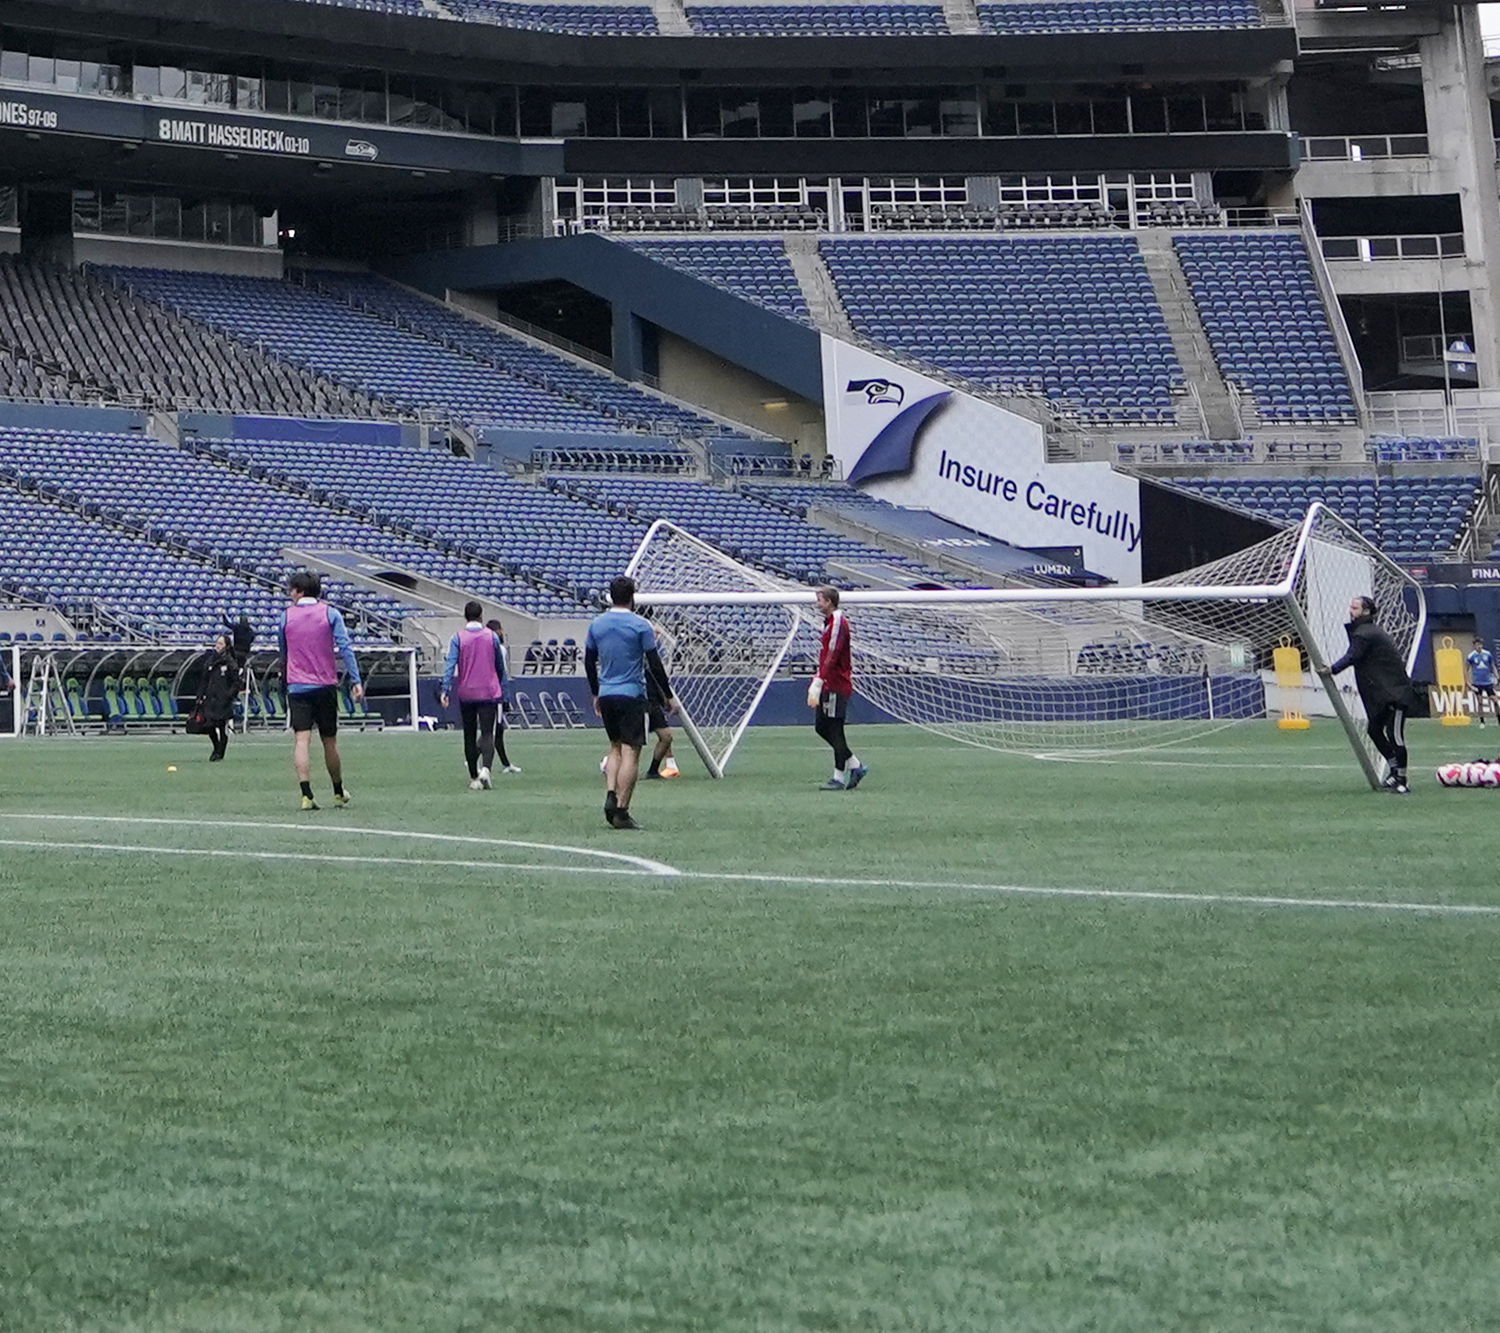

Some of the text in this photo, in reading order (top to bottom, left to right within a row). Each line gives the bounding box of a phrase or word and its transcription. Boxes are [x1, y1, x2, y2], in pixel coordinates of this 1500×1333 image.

[27, 108, 58, 129] 97-09
[159, 119, 310, 156] 8 MATT HASSELBECK 01-10
[938, 449, 1142, 552] Insure Carefully
[1033, 564, 1072, 576] LUMEN
